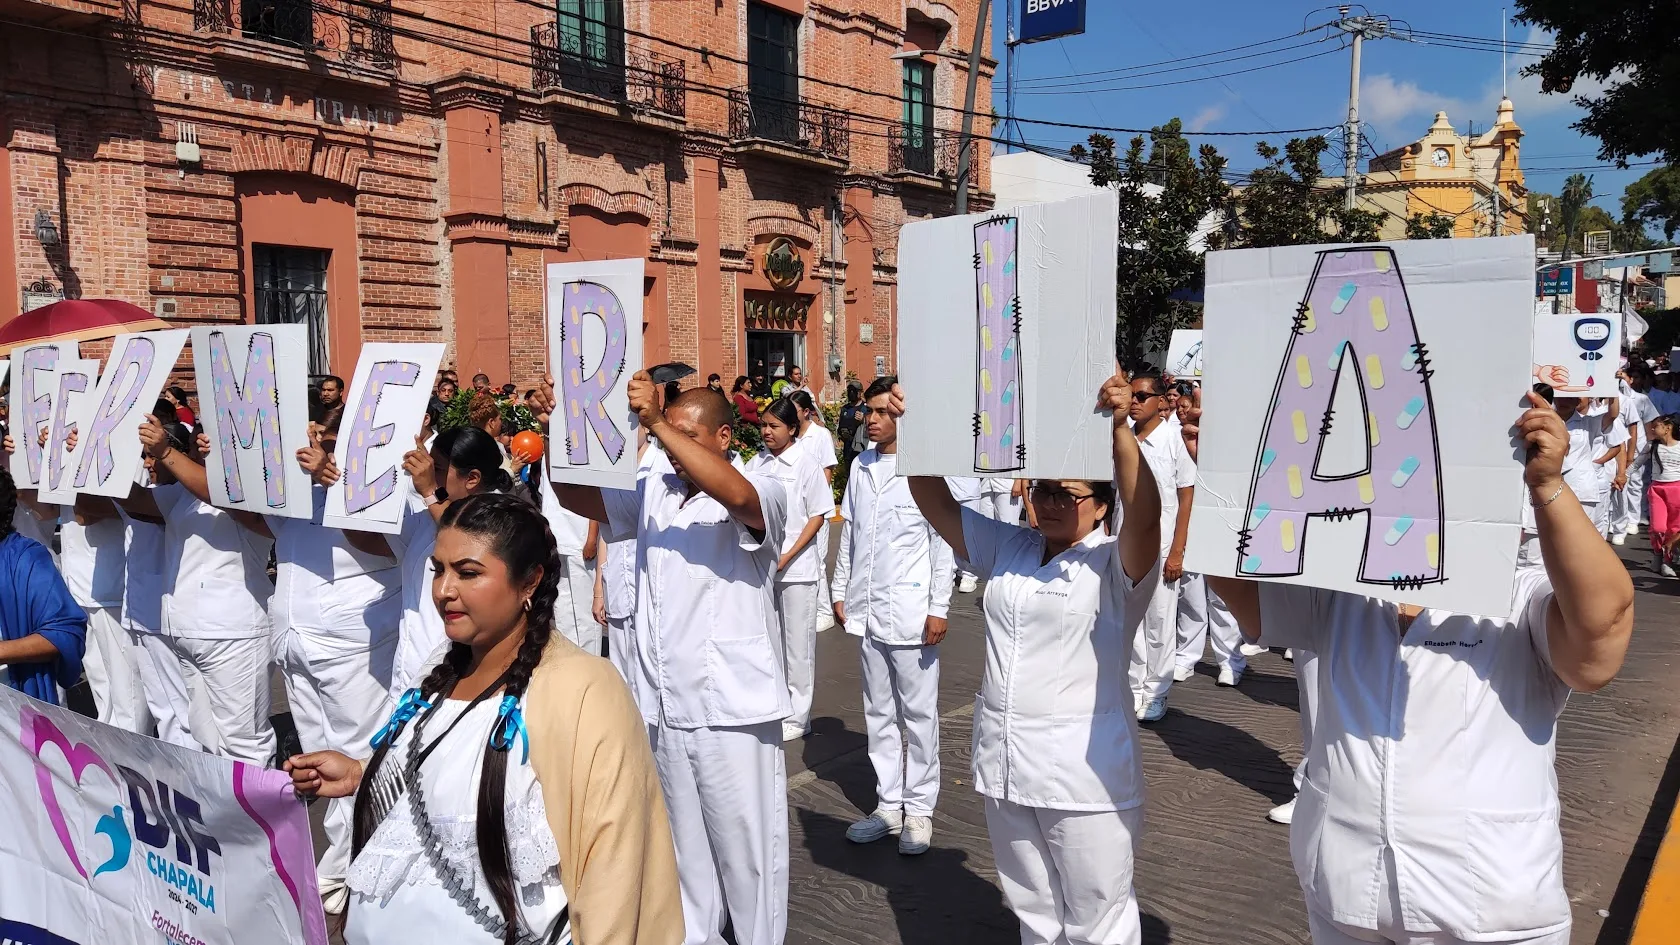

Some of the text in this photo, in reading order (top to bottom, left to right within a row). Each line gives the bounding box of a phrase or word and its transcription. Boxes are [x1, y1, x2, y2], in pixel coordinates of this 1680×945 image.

[73, 337, 156, 488] R
[209, 330, 286, 508] M
[560, 279, 627, 466] R
[972, 213, 1026, 473] I
[1236, 246, 1449, 590] A
[343, 359, 421, 515] E
[114, 763, 222, 877] DIF
[146, 851, 216, 914] CHAPALA
